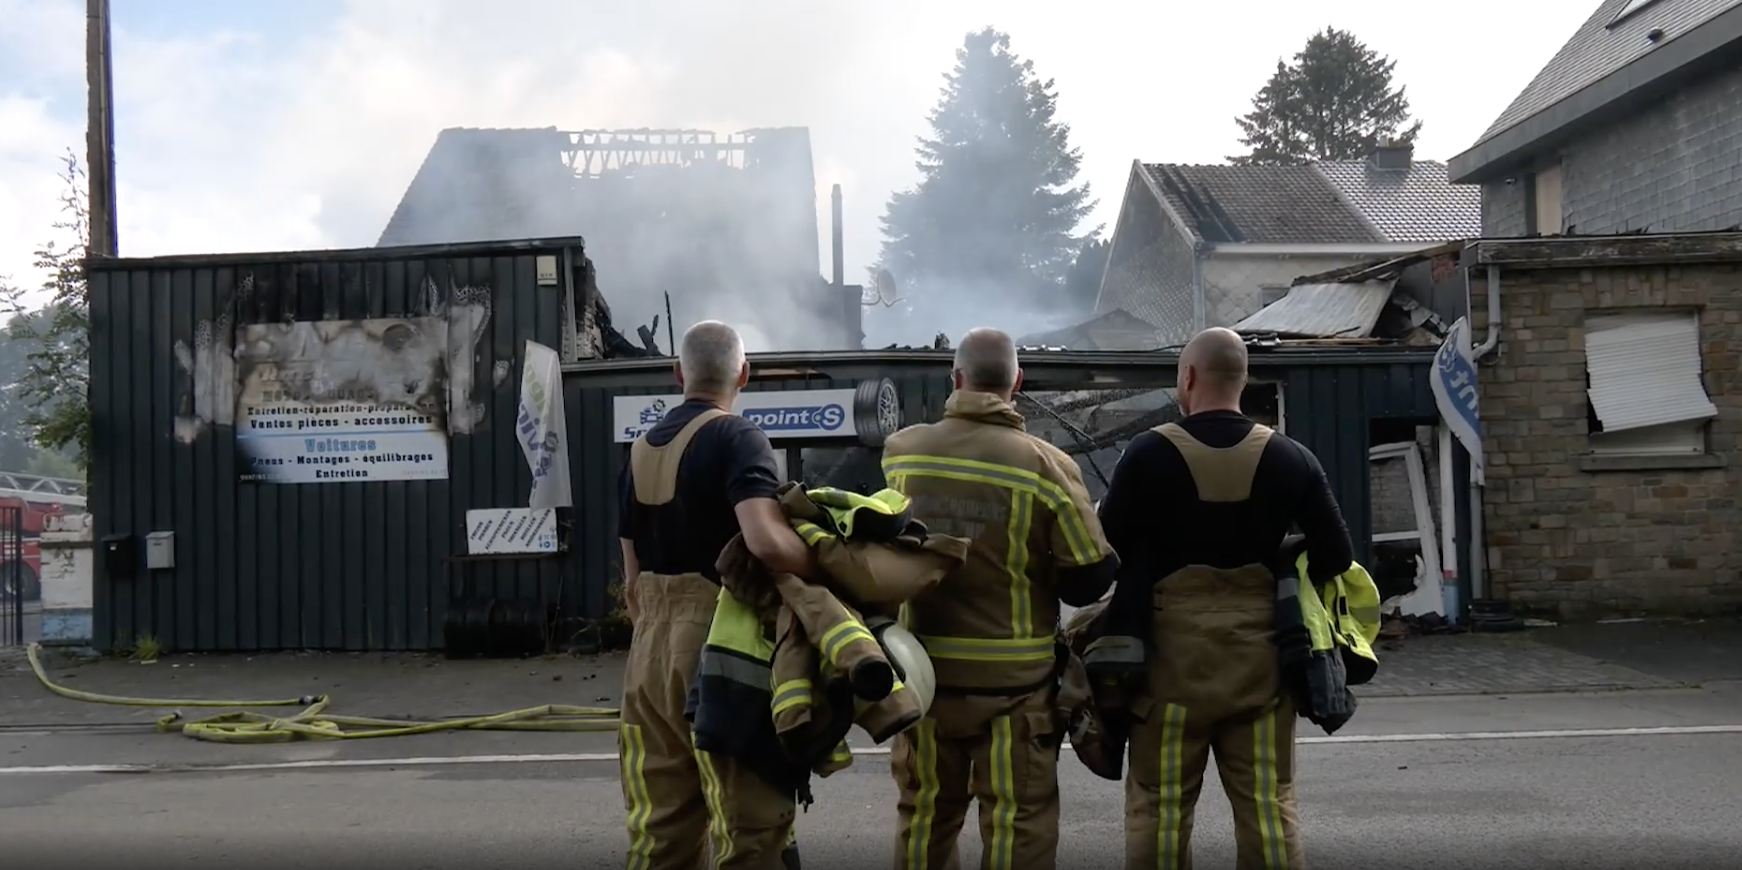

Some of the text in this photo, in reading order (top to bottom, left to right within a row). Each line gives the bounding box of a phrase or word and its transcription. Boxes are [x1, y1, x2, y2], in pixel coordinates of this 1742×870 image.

[251, 419, 293, 429] Ventes
[298, 417, 339, 430] pièces
[354, 415, 433, 427] accessoires
[748, 407, 841, 427] point S
[305, 438, 377, 453] Voitures
[252, 456, 284, 466] Pneus
[297, 454, 351, 466] Montages
[363, 452, 433, 465] équilibrages
[315, 468, 369, 479] Entretien
